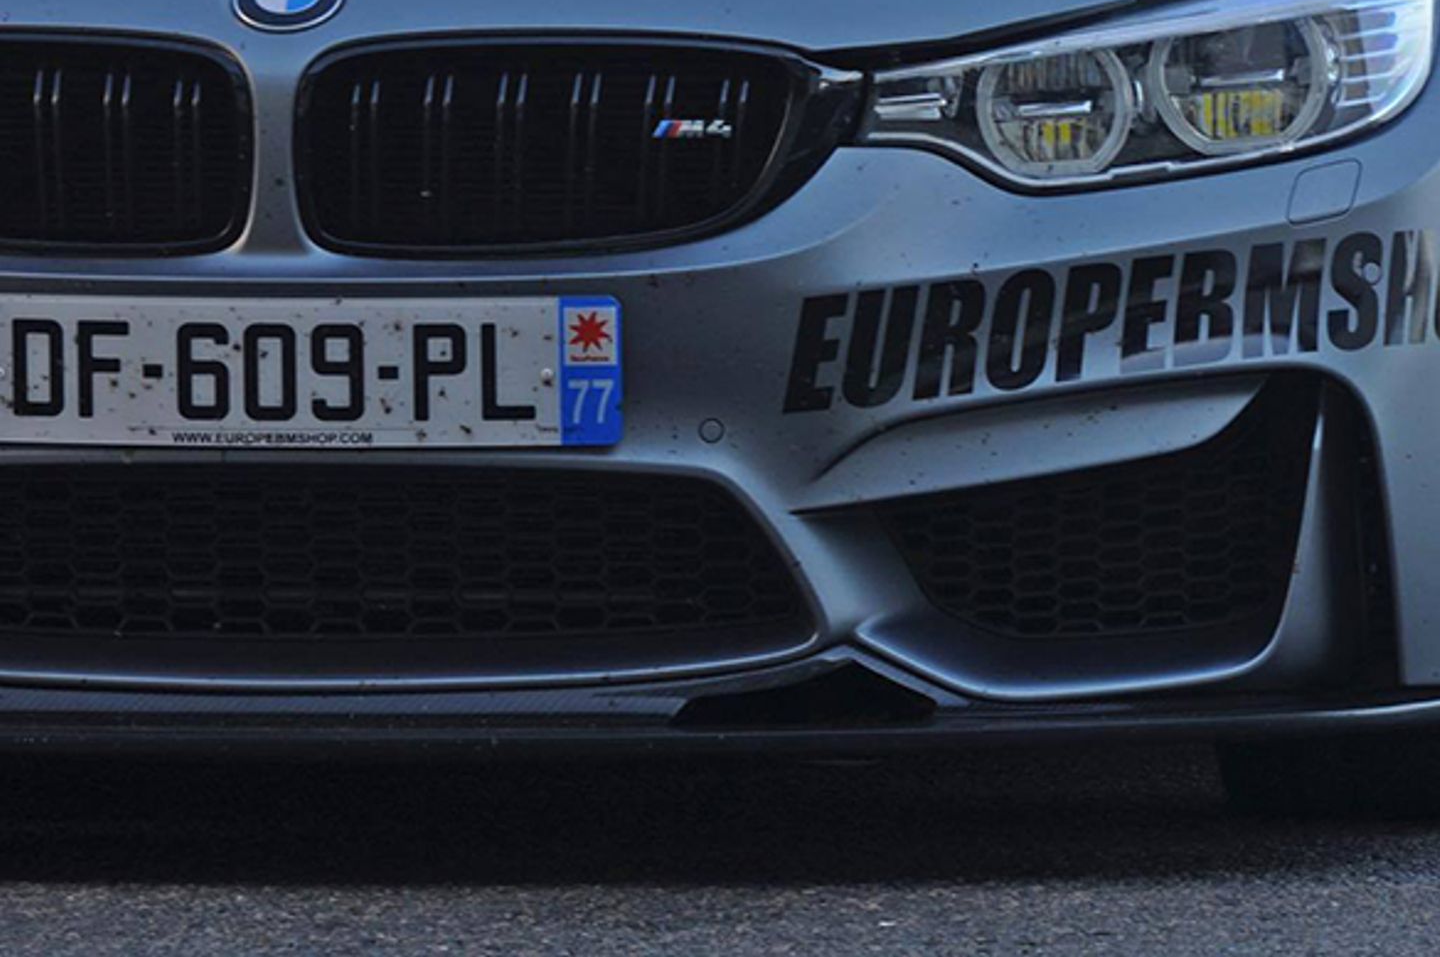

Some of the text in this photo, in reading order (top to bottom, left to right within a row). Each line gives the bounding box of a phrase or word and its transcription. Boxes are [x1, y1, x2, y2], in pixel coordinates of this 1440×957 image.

[677, 119, 732, 138] M4
[12, 318, 536, 422] DF-609-PL
[567, 378, 614, 424] 77
